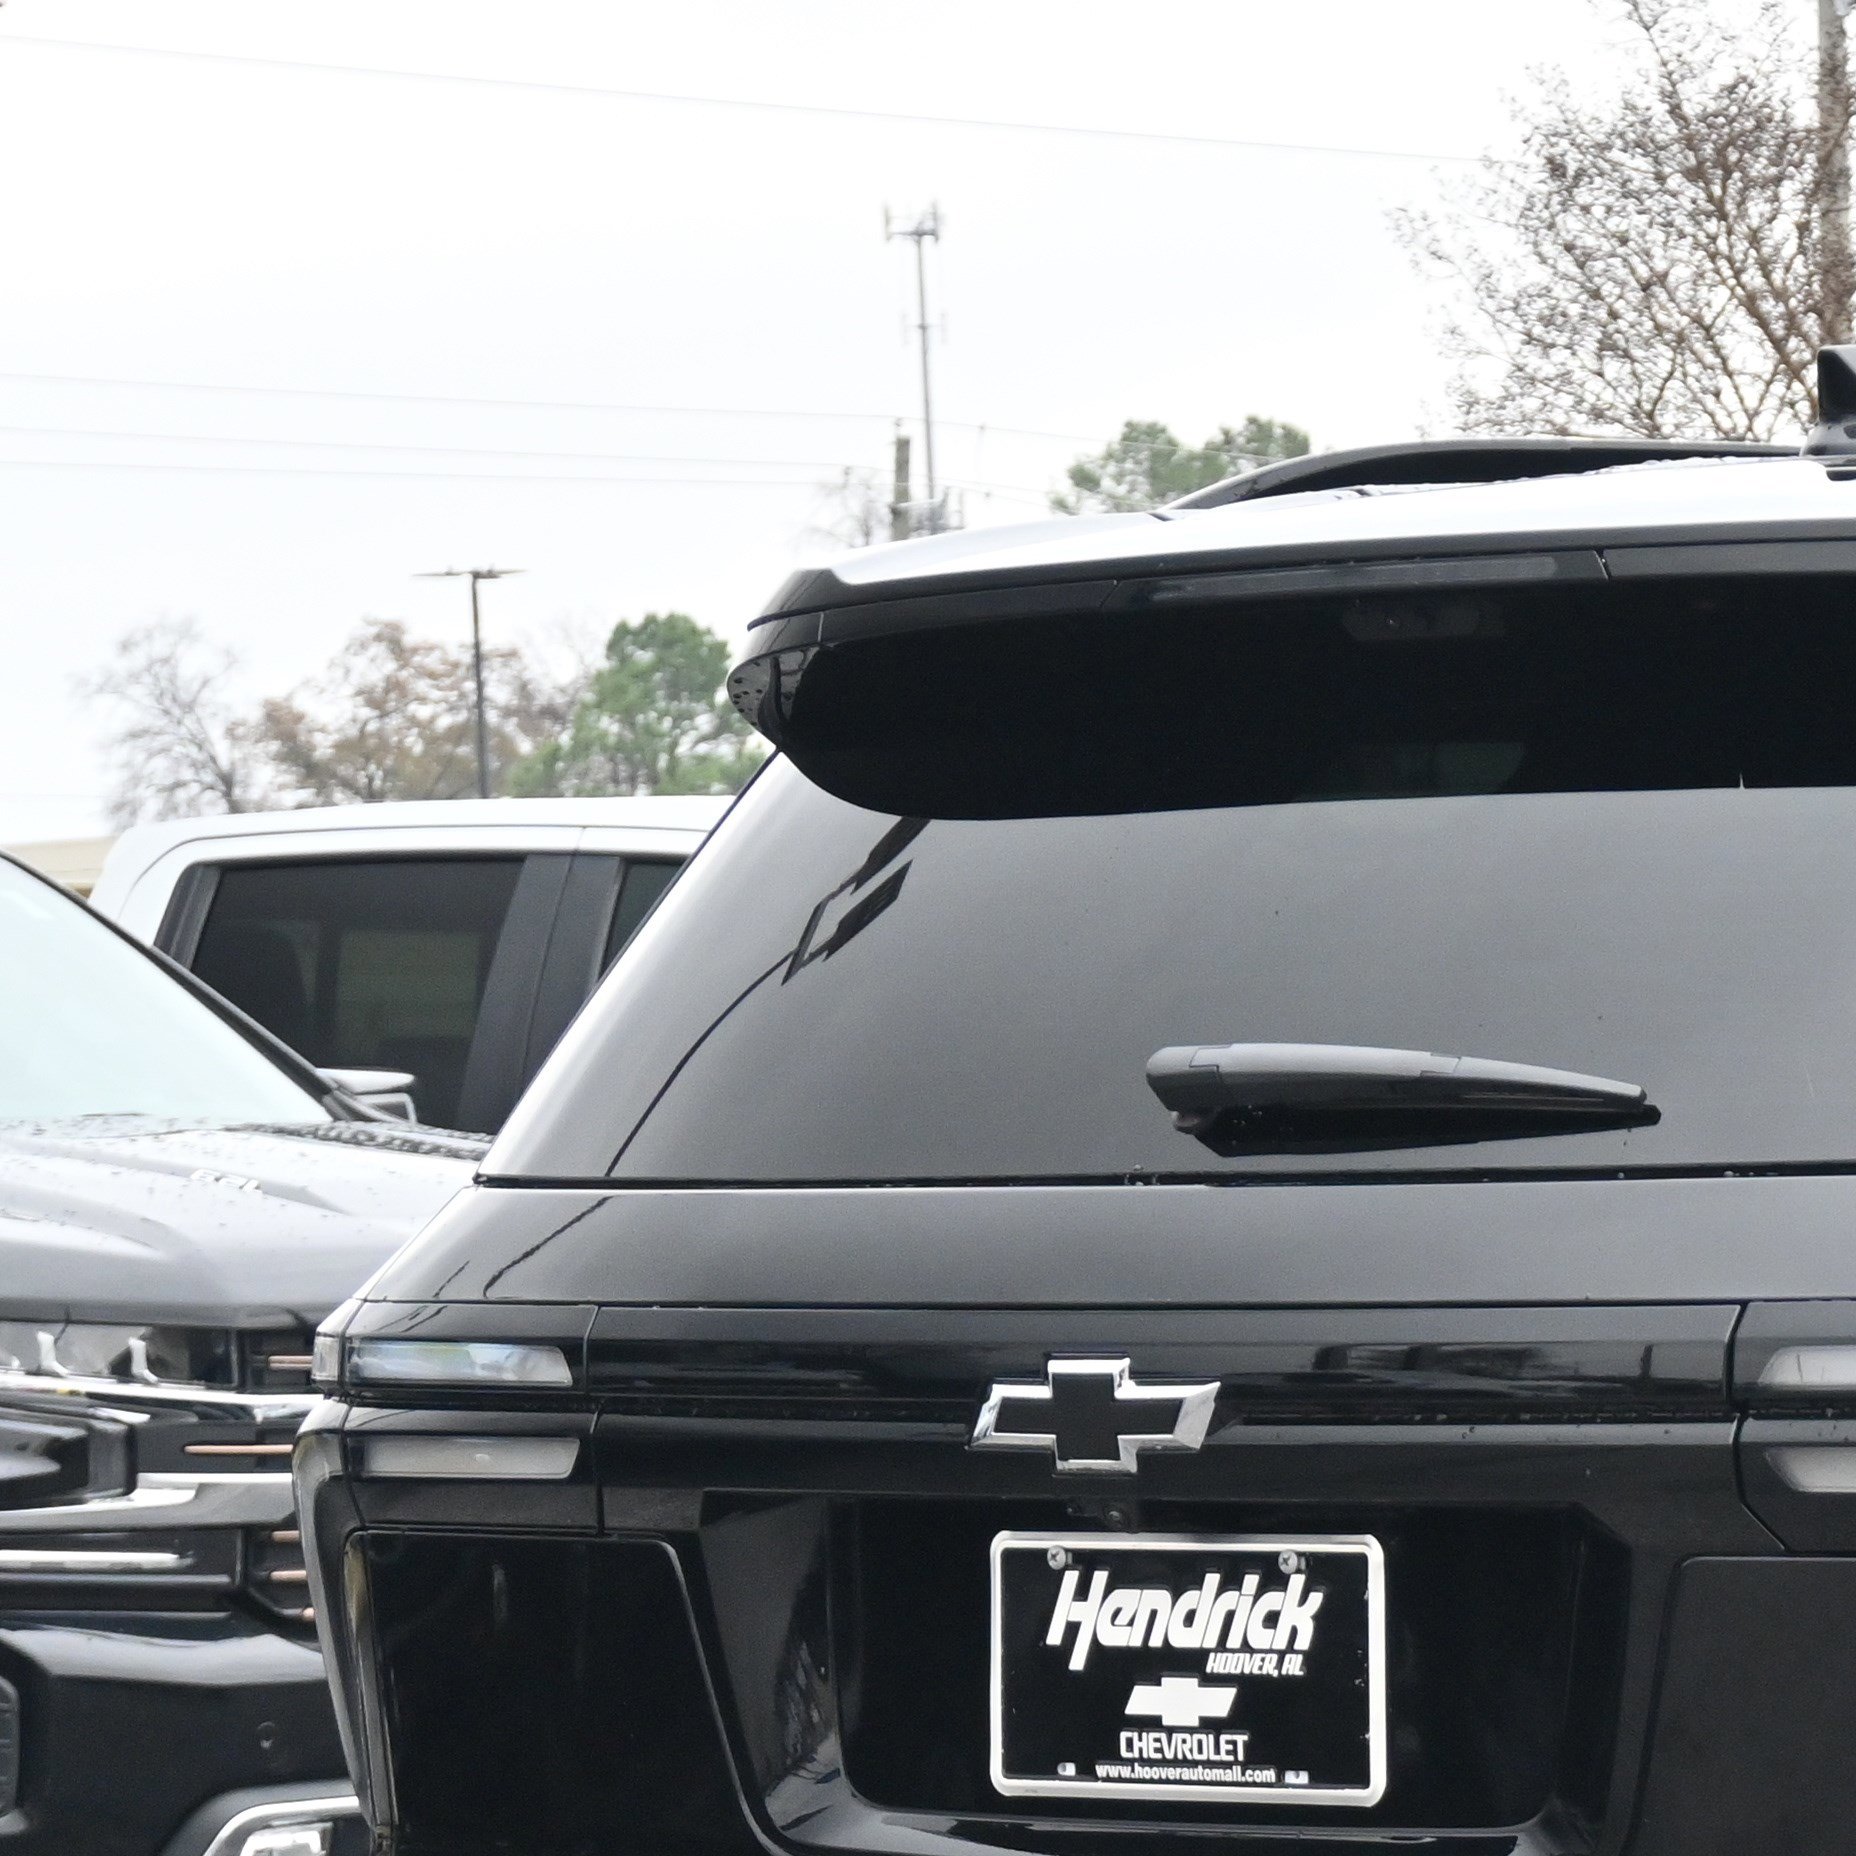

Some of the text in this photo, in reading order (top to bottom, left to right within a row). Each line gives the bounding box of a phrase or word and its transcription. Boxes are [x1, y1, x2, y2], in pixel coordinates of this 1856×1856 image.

[1045, 1570, 1324, 1671] Hendrick
[1205, 1652, 1304, 1677] HOOVER, AL
[1119, 1731, 1249, 1762] CHEVROLET
[1095, 1762, 1277, 1783] www.hooverautomall.com
